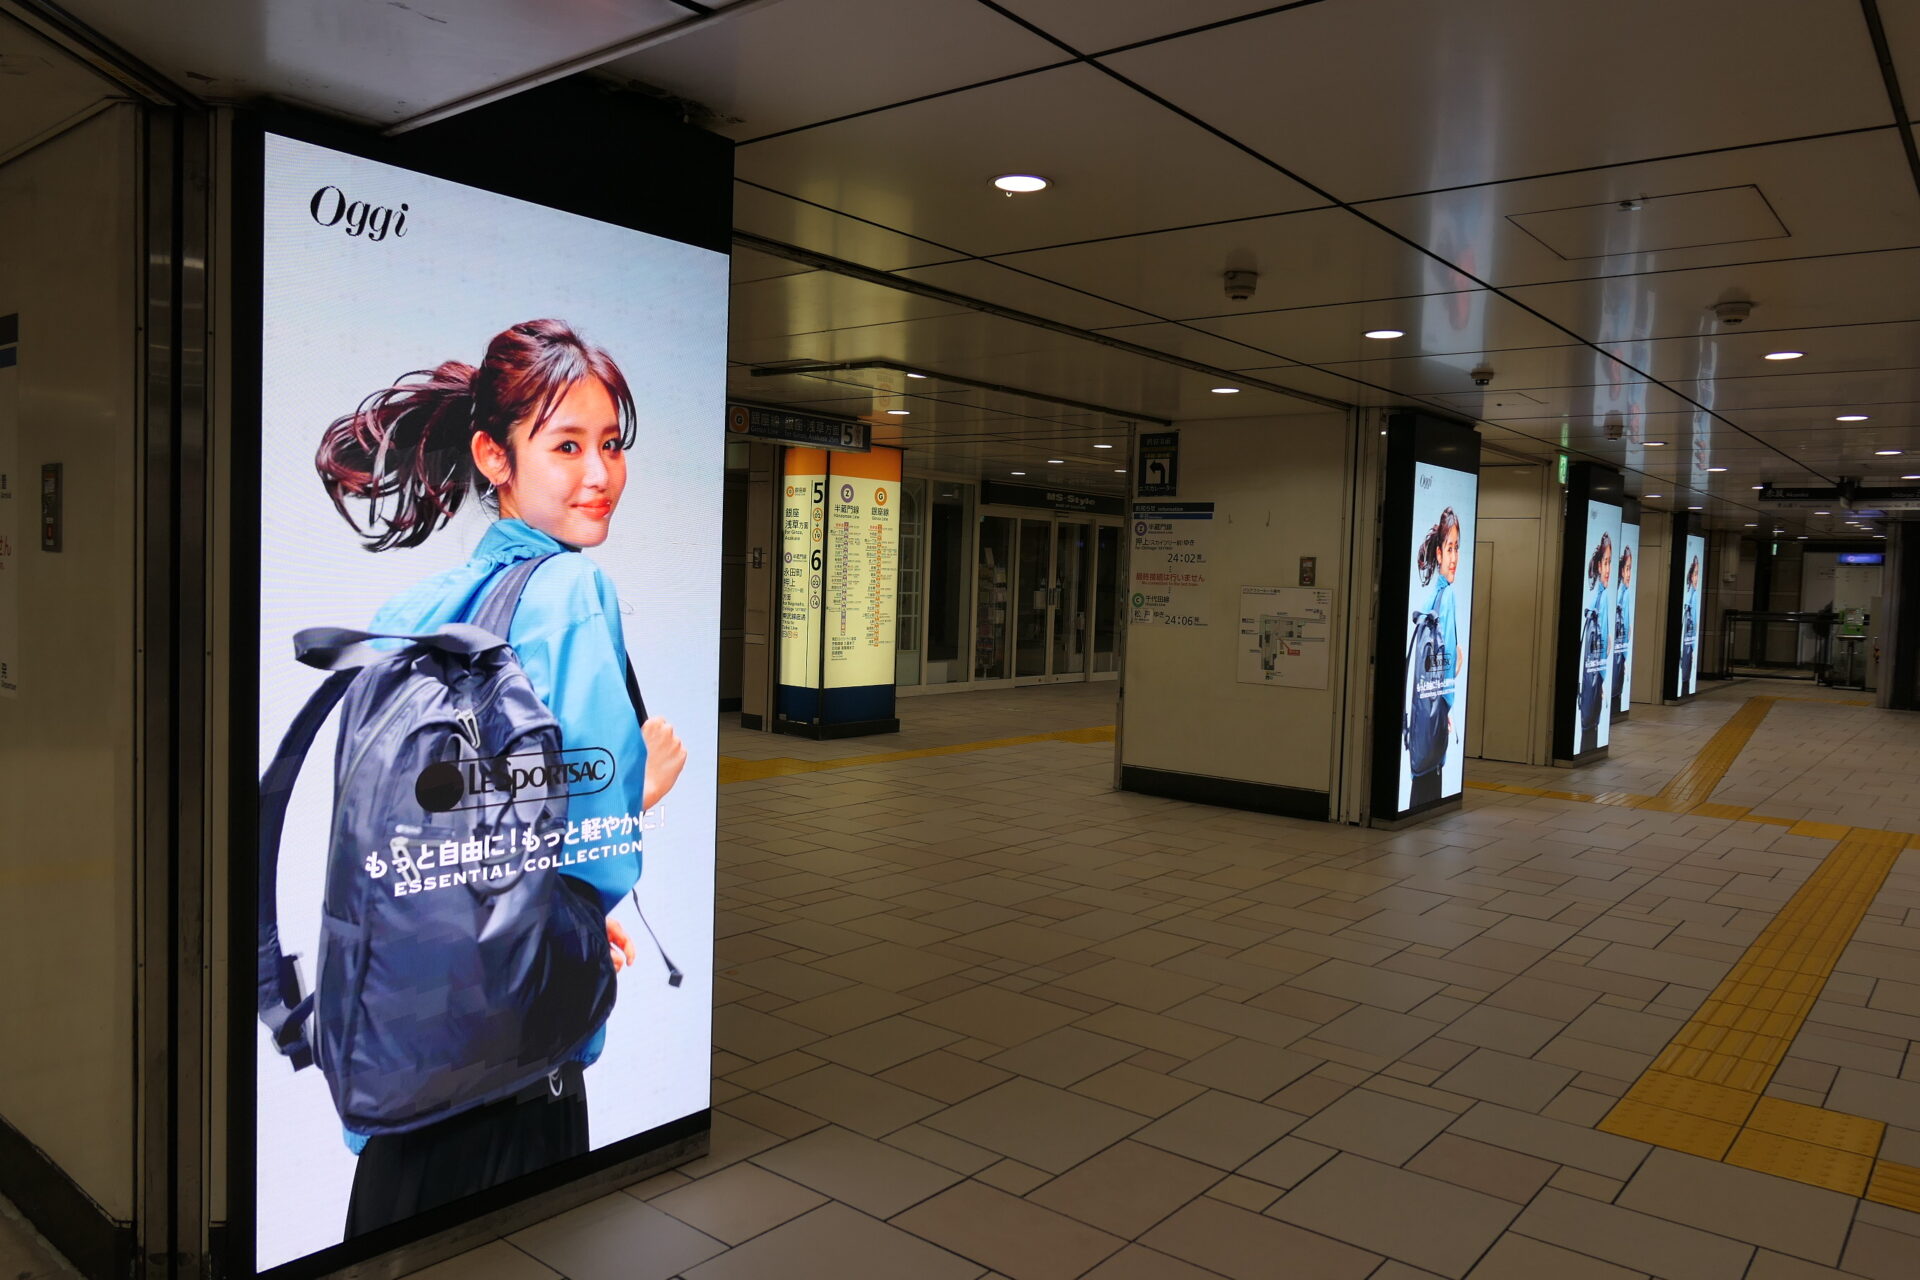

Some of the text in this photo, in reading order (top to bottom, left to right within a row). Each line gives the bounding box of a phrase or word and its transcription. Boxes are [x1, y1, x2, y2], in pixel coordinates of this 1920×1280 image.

[310, 185, 409, 241] Oggi
[843, 425, 853, 445] 5
[813, 482, 824, 503] 5
[811, 549, 821, 571] 6
[1167, 553, 1196, 563] 24:02
[1165, 616, 1193, 626] 24:06
[394, 839, 643, 897] ESSENTIAL COLLECTION
